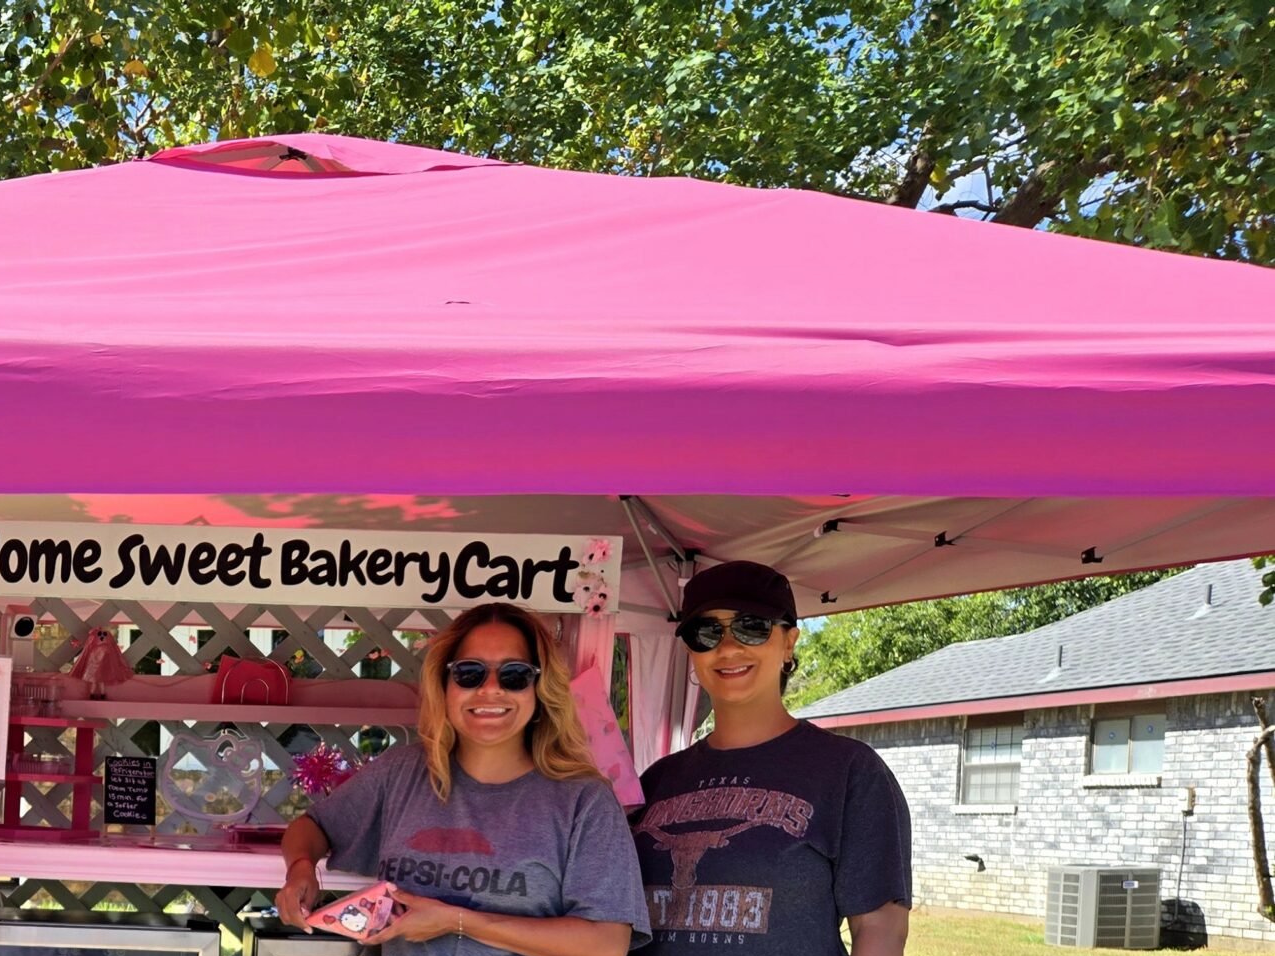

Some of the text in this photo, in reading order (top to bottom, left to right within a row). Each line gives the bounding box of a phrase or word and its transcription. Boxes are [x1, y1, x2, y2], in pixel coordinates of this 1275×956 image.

[109, 532, 272, 589] Sweet
[281, 539, 450, 603] Bakery
[453, 541, 579, 603] Cart
[107, 758, 140, 767] Cookies
[698, 776, 752, 788] TEXAS
[641, 786, 815, 838] ONGHORNS
[685, 888, 765, 929] 1883
[689, 932, 746, 945] HORNS
